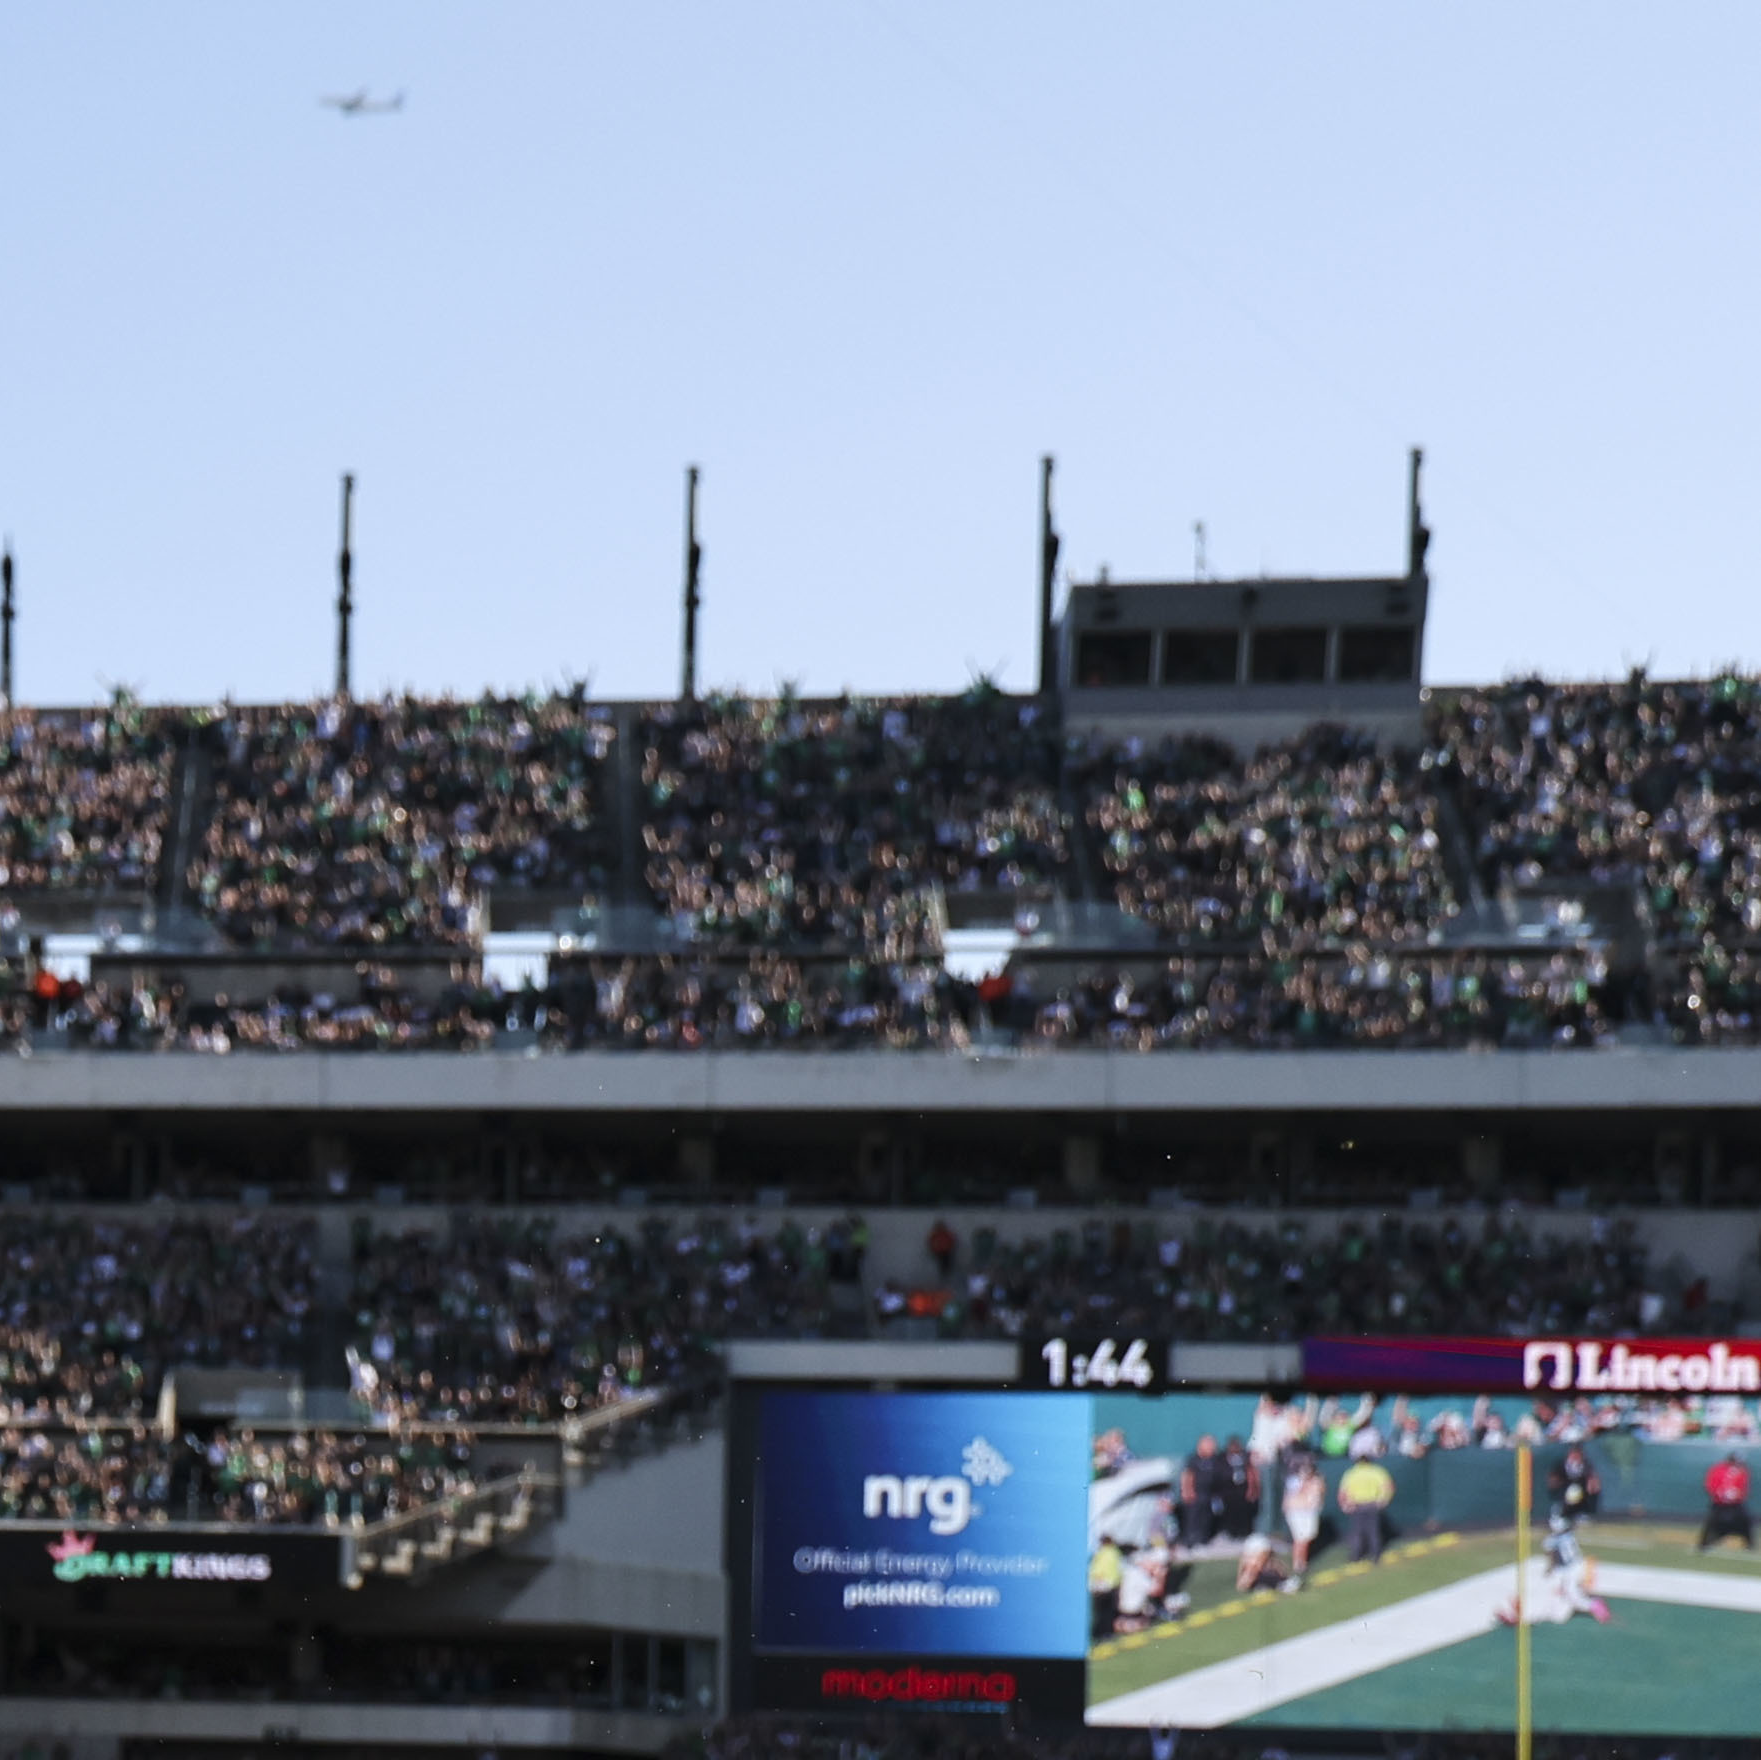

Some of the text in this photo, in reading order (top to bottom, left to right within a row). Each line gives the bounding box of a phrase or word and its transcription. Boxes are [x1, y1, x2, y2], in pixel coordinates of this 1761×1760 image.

[1042, 1338, 1154, 1388] 1:44
[1576, 1341, 1761, 1391] Lincoln
[863, 1474, 972, 1535] nrg
[793, 1547, 1050, 1579] Official Energy Provider
[821, 1663, 1019, 1702] moderna
